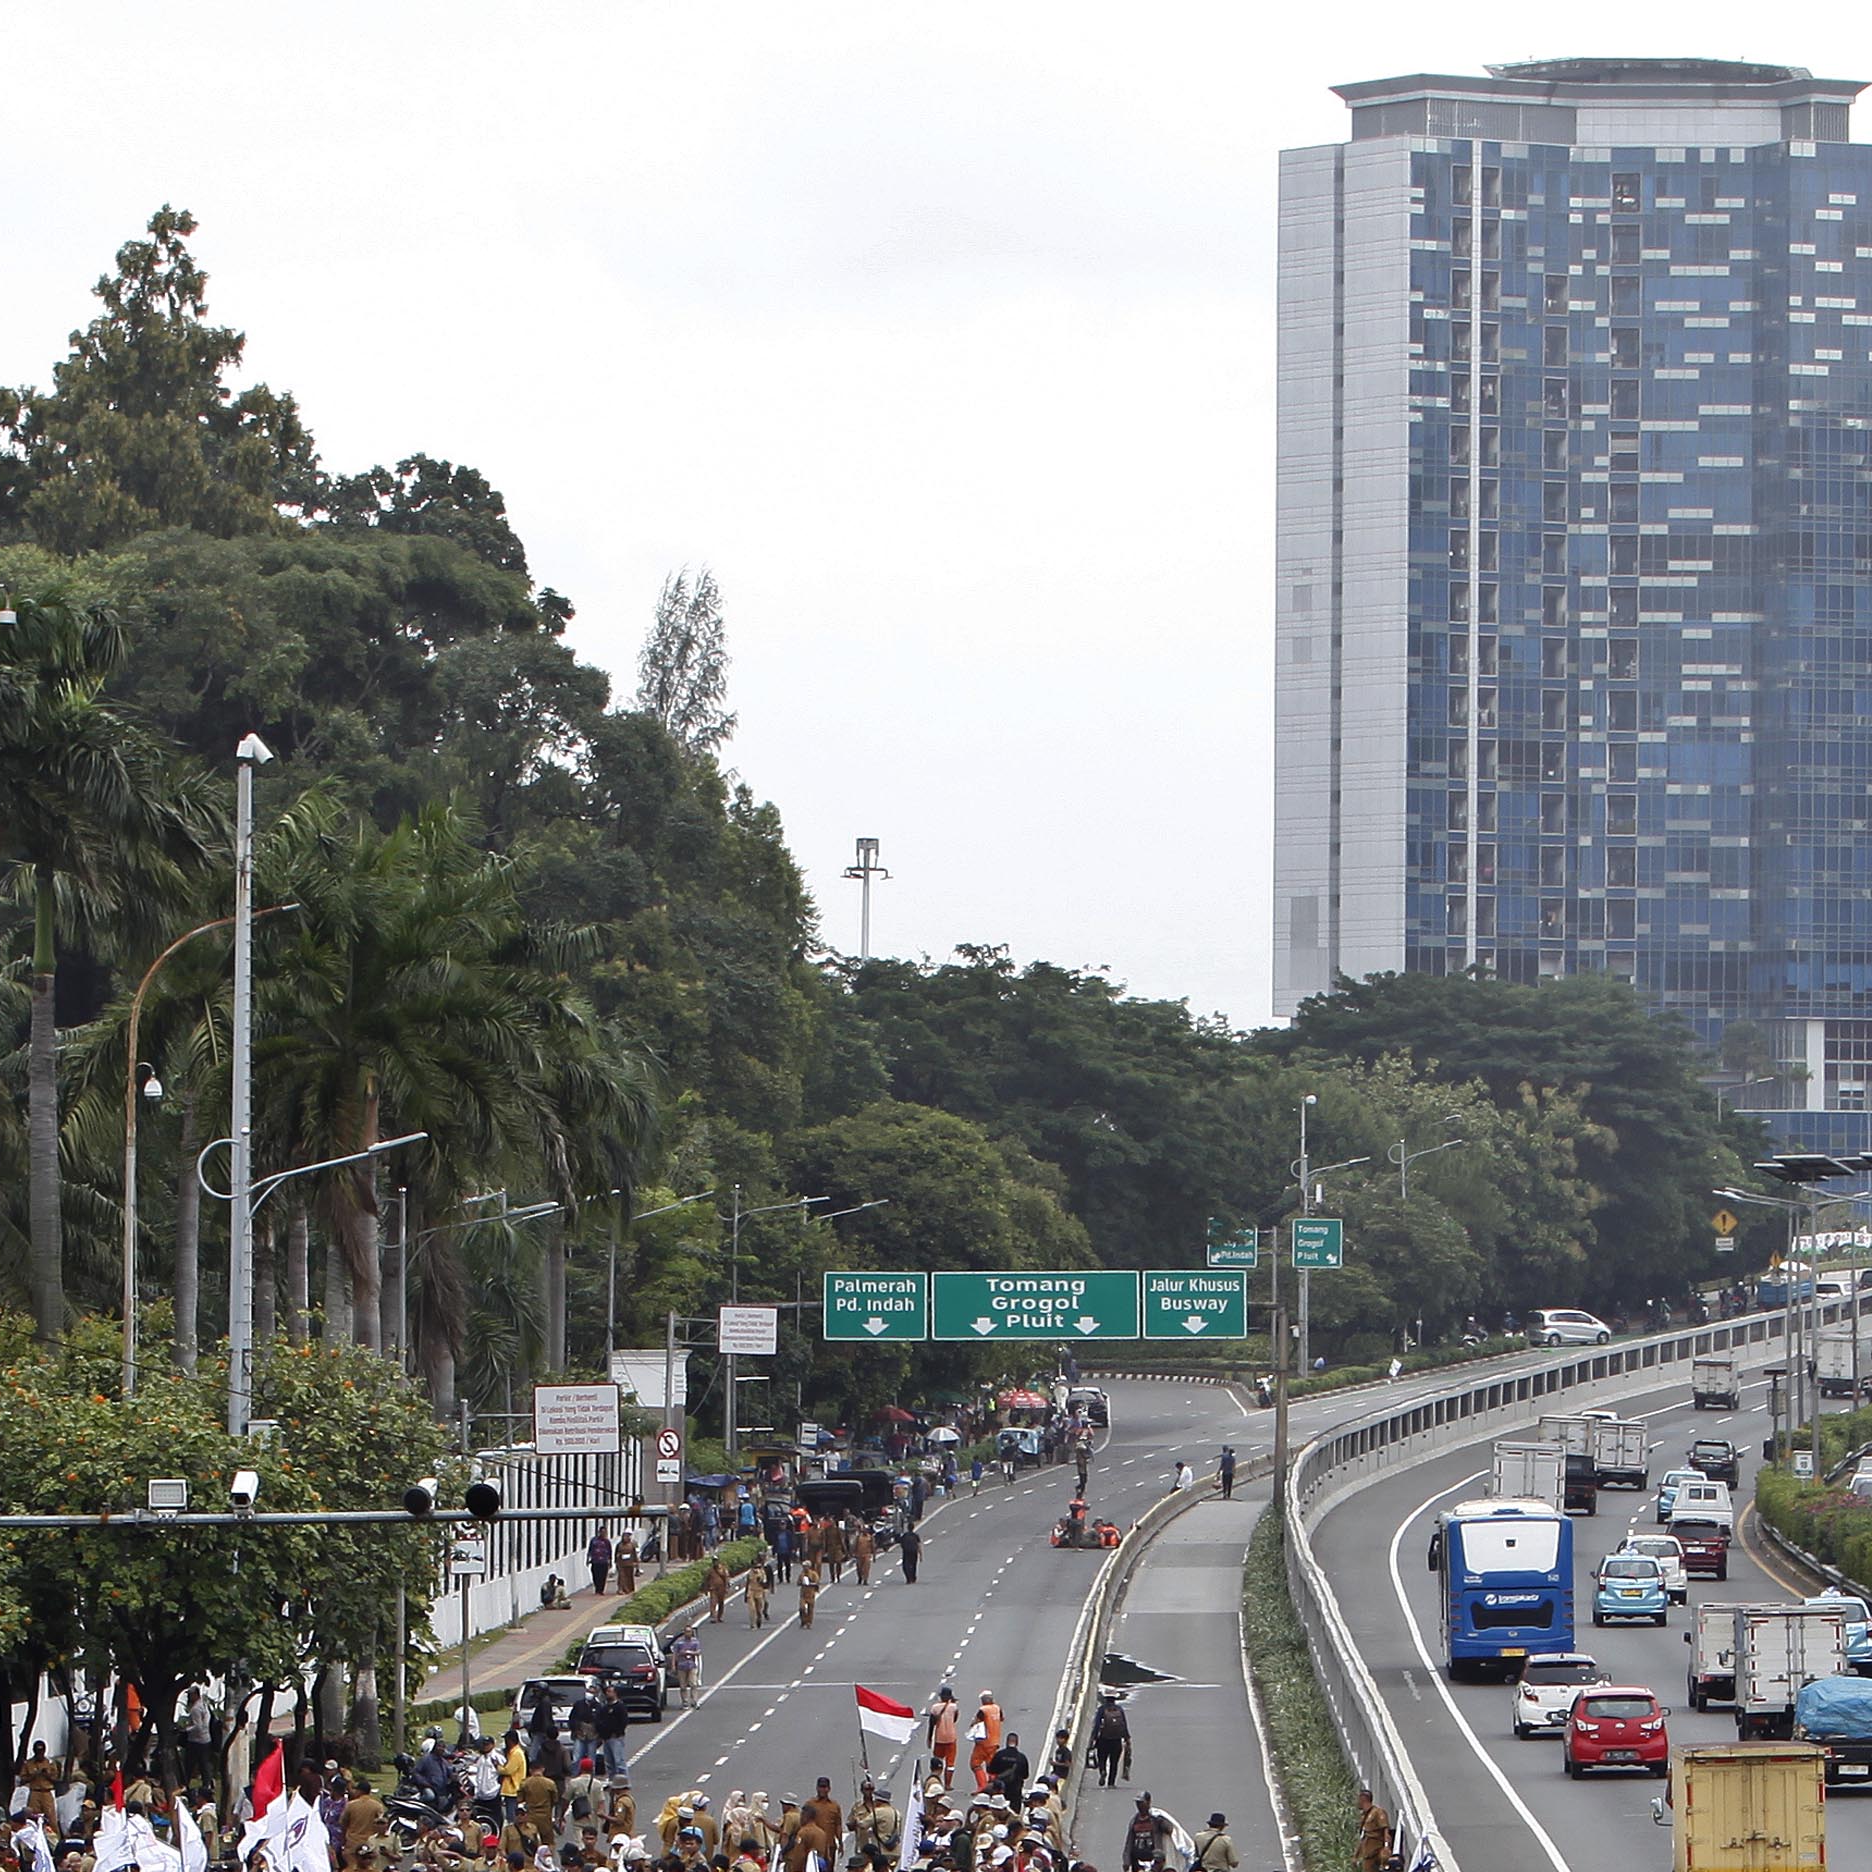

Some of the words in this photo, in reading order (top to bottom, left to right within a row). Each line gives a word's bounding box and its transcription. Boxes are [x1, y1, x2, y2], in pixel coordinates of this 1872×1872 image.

[1297, 1225, 1329, 1235] Tomang
[1297, 1239, 1324, 1250] Grogol
[1297, 1252, 1319, 1260] Pluit
[834, 1279, 917, 1294] Palmerah
[986, 1278, 1086, 1296] Tomang
[1149, 1278, 1185, 1292] Jalur
[1188, 1277, 1240, 1292] Khusus
[836, 1298, 862, 1312] Pd.
[867, 1297, 915, 1312] Indah
[991, 1296, 1080, 1314] Grogol
[1160, 1298, 1228, 1314] Busway
[1006, 1313, 1064, 1329] Pluit
